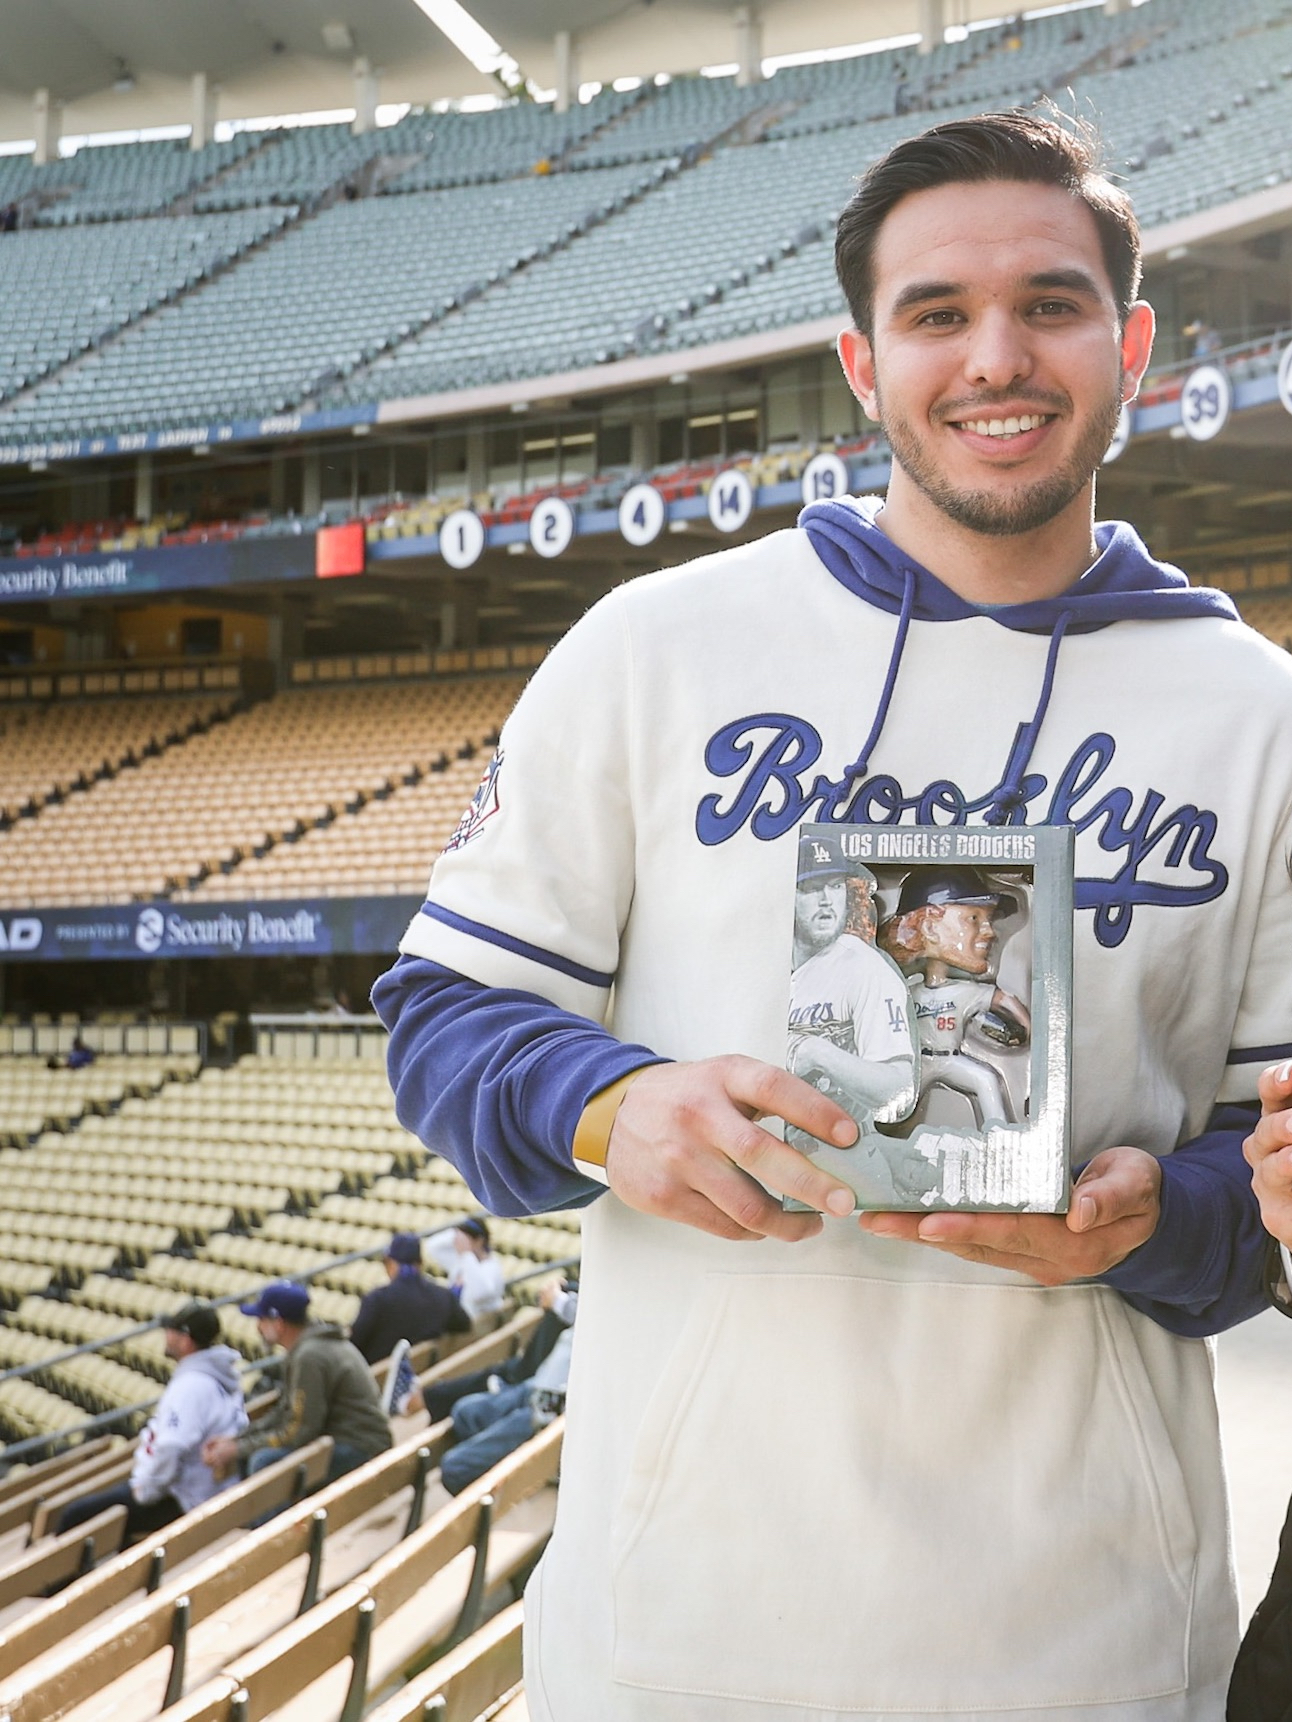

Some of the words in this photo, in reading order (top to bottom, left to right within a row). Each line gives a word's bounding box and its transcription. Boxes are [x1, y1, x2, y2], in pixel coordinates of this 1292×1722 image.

[1189, 386, 1222, 421] 39
[813, 469, 835, 501] 19
[633, 501, 647, 528] 4
[719, 490, 740, 518] 14
[458, 525, 466, 552] 1
[543, 514, 557, 541] 2
[695, 712, 1229, 948] Brooklyn
[840, 833, 872, 858] LOS
[877, 833, 951, 858] ANGELES
[956, 834, 1036, 860] DODGERS
[166, 912, 245, 951] Security
[248, 909, 317, 943] Benefit
[936, 1016, 957, 1032] 85
